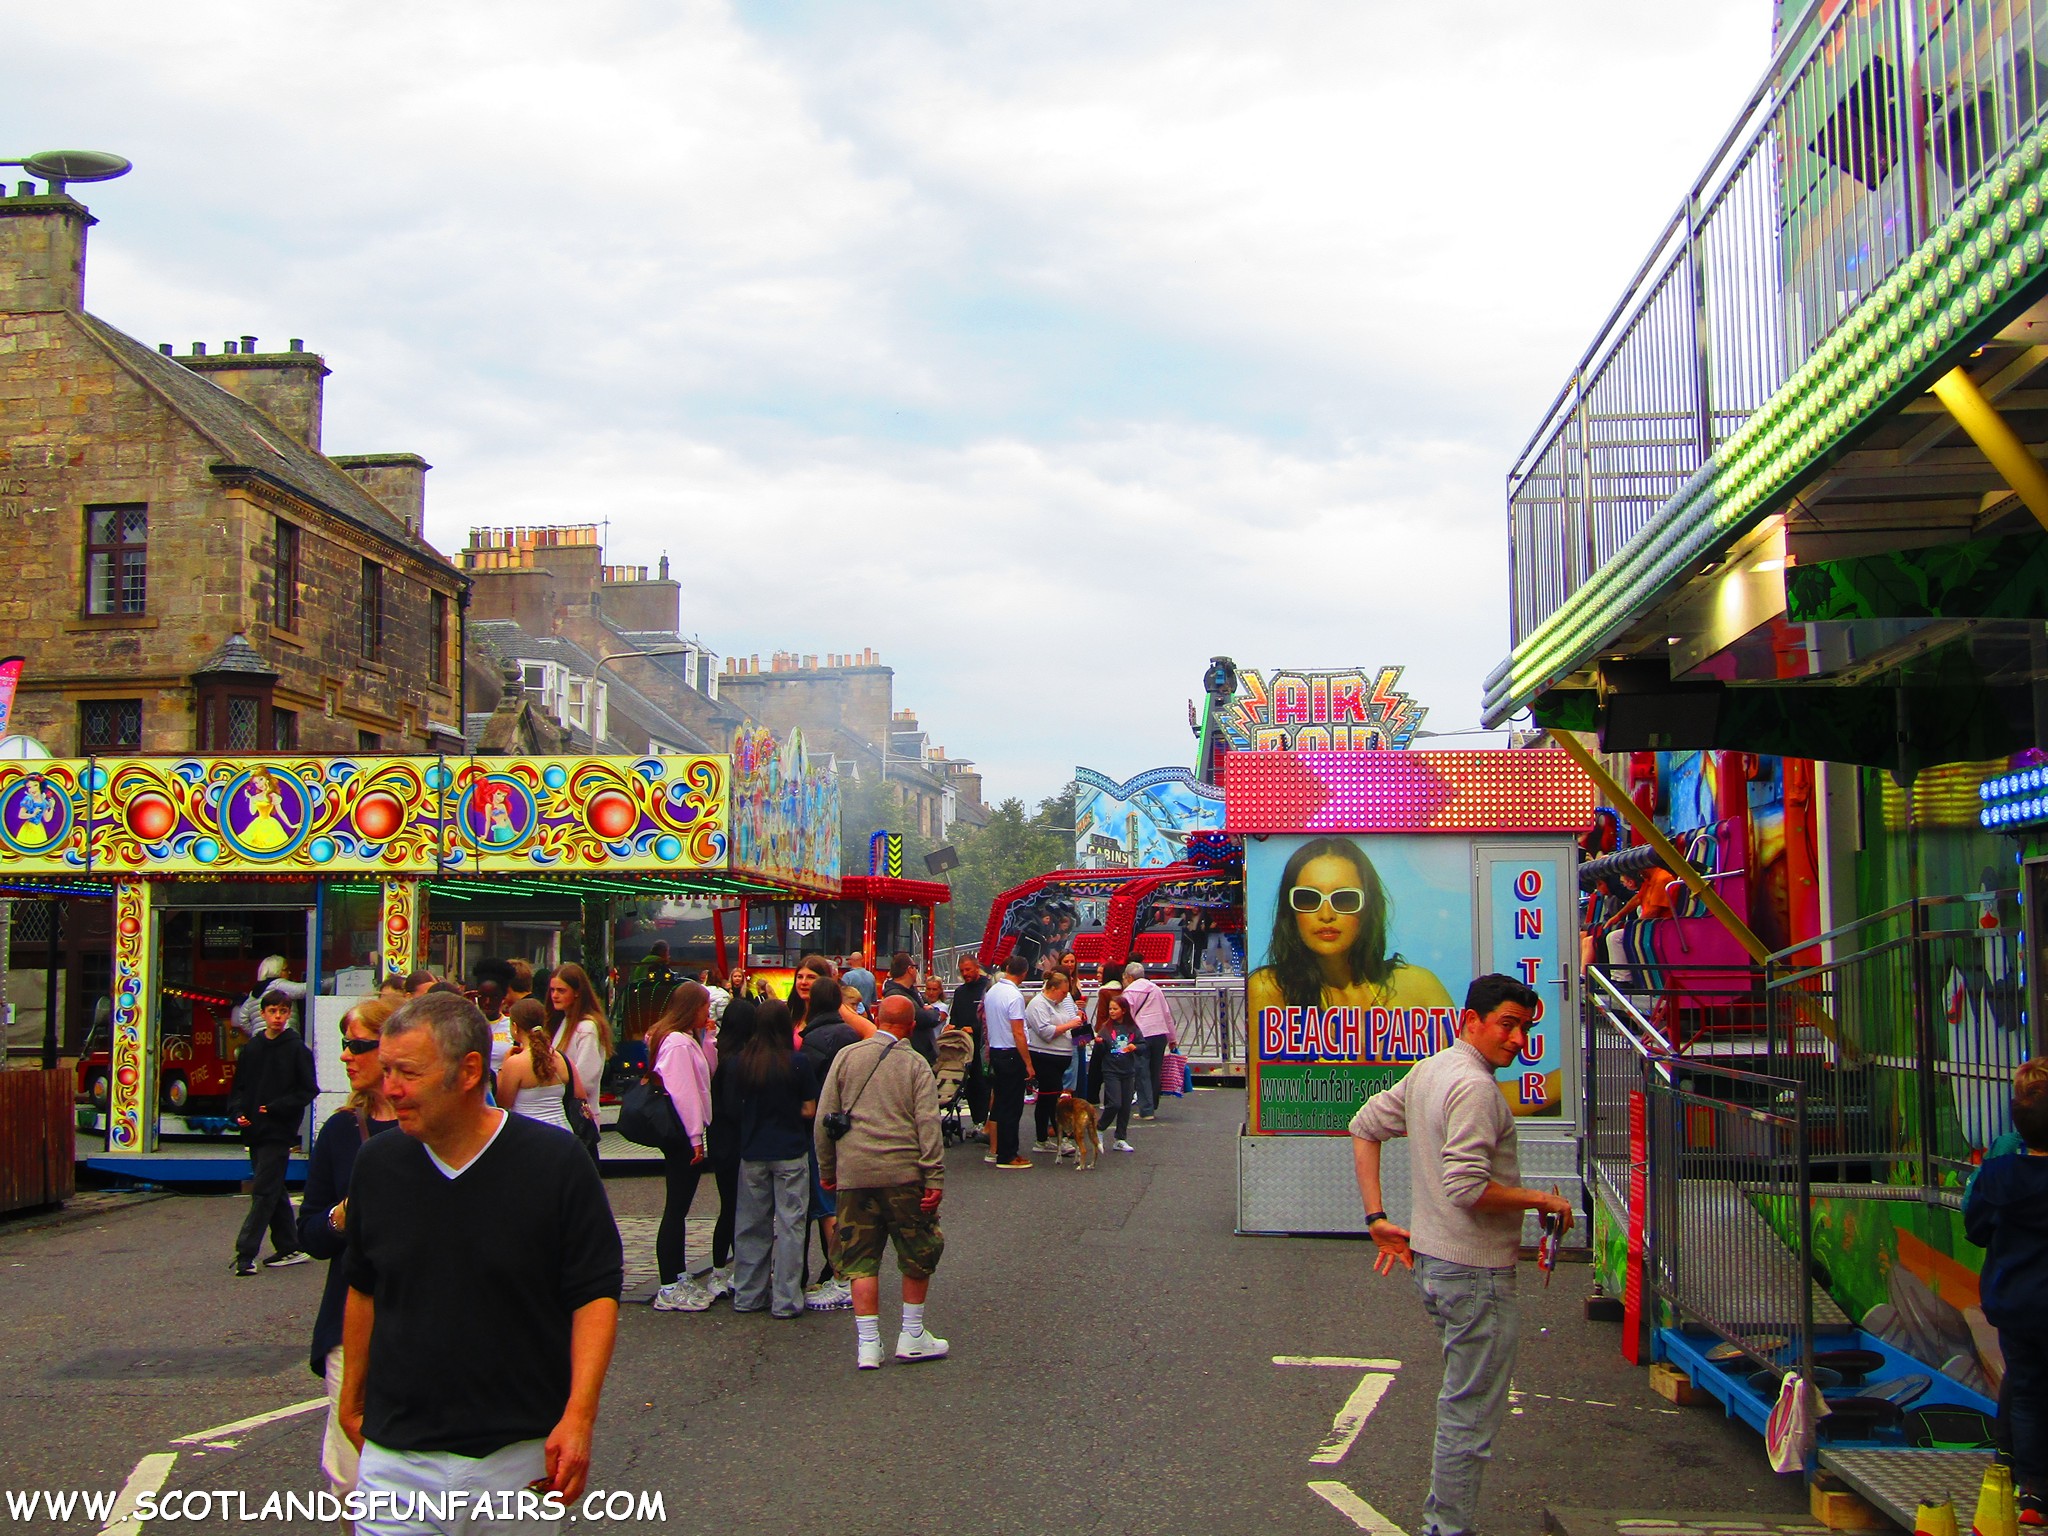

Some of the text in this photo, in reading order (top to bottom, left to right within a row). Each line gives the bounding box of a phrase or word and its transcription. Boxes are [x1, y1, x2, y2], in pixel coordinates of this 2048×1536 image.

[1273, 675, 1369, 725] AIR
[1088, 845, 1128, 864] CABINS
[793, 903, 818, 916] PAY
[1513, 869, 1544, 939] ON
[788, 917, 821, 930] HERE
[195, 1031, 213, 1045] 999
[1260, 1005, 1362, 1057] BEACH
[190, 1064, 210, 1086] FIRE
[1261, 1069, 1399, 1103] www.funfair-scotl
[1261, 1107, 1275, 1129] all
[1276, 1107, 1303, 1129] kinds
[1305, 1107, 1317, 1129] of
[1318, 1108, 1344, 1129] rides
